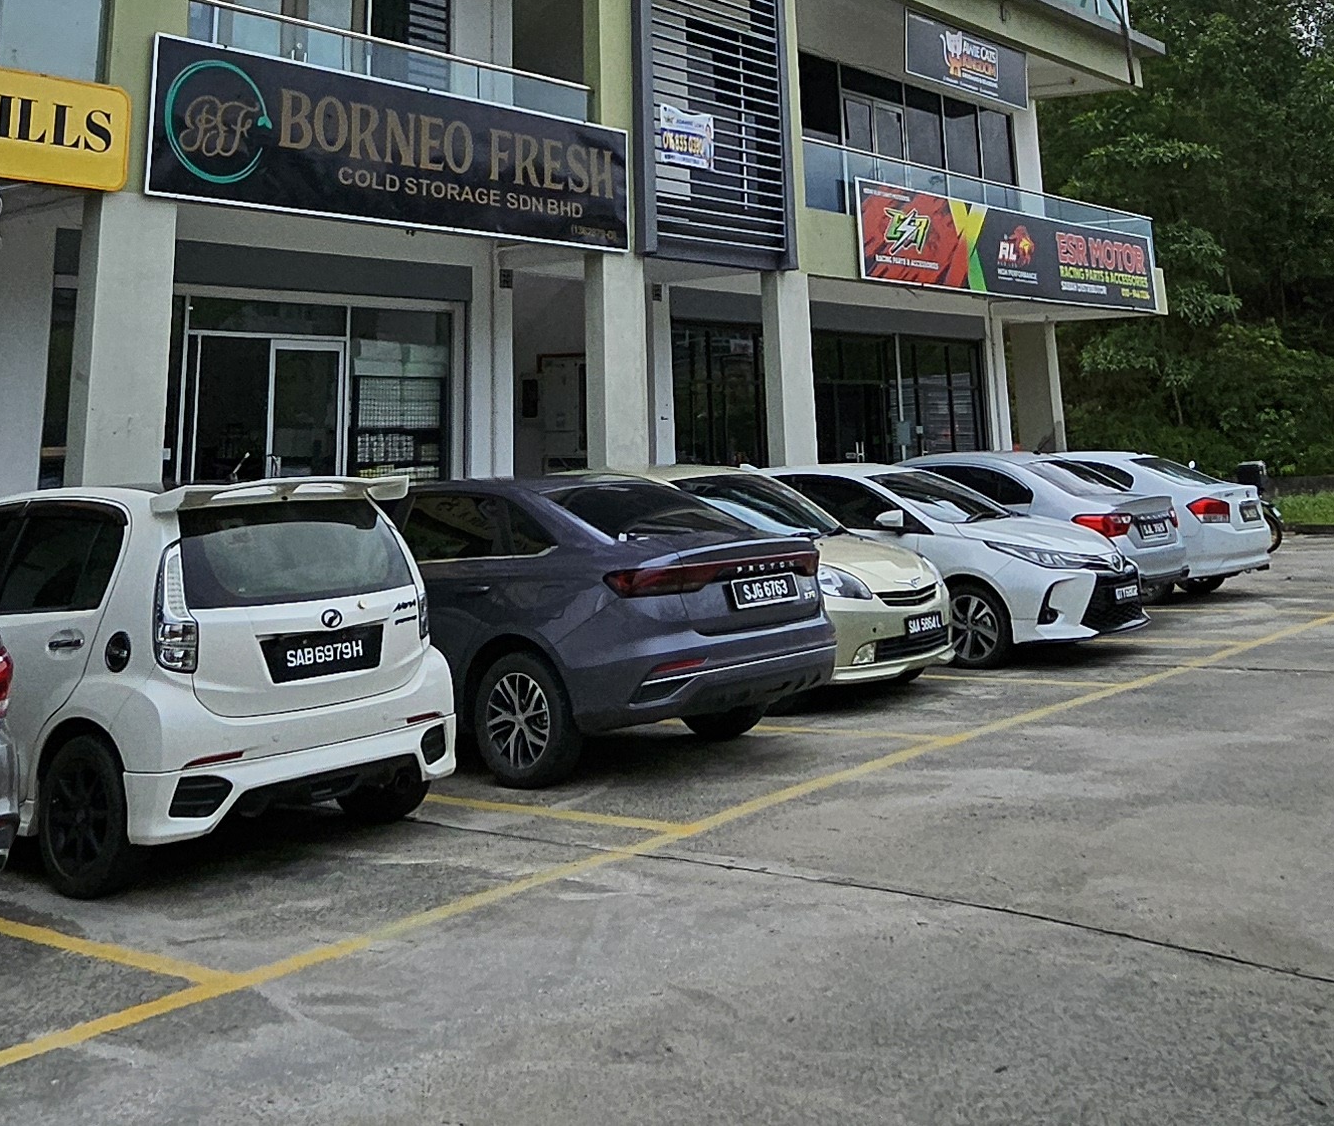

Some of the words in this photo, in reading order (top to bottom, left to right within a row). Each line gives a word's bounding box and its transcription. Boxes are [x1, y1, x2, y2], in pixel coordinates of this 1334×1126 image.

[278, 88, 474, 176] BORNEO
[490, 128, 615, 200] FRESH
[338, 166, 401, 192] COLD
[405, 178, 500, 209] STORAGE
[506, 191, 544, 214] SDN
[547, 198, 583, 219] BHD
[1055, 232, 1089, 266] ESR
[1088, 237, 1147, 275] MOTOR
[1059, 265, 1085, 280] RACING
[1085, 268, 1105, 282] PARTS
[1109, 272, 1148, 289] ACCESSORIES
[737, 560, 795, 573] PROTON
[743, 582, 764, 601] SJG
[763, 579, 788, 595] 6763
